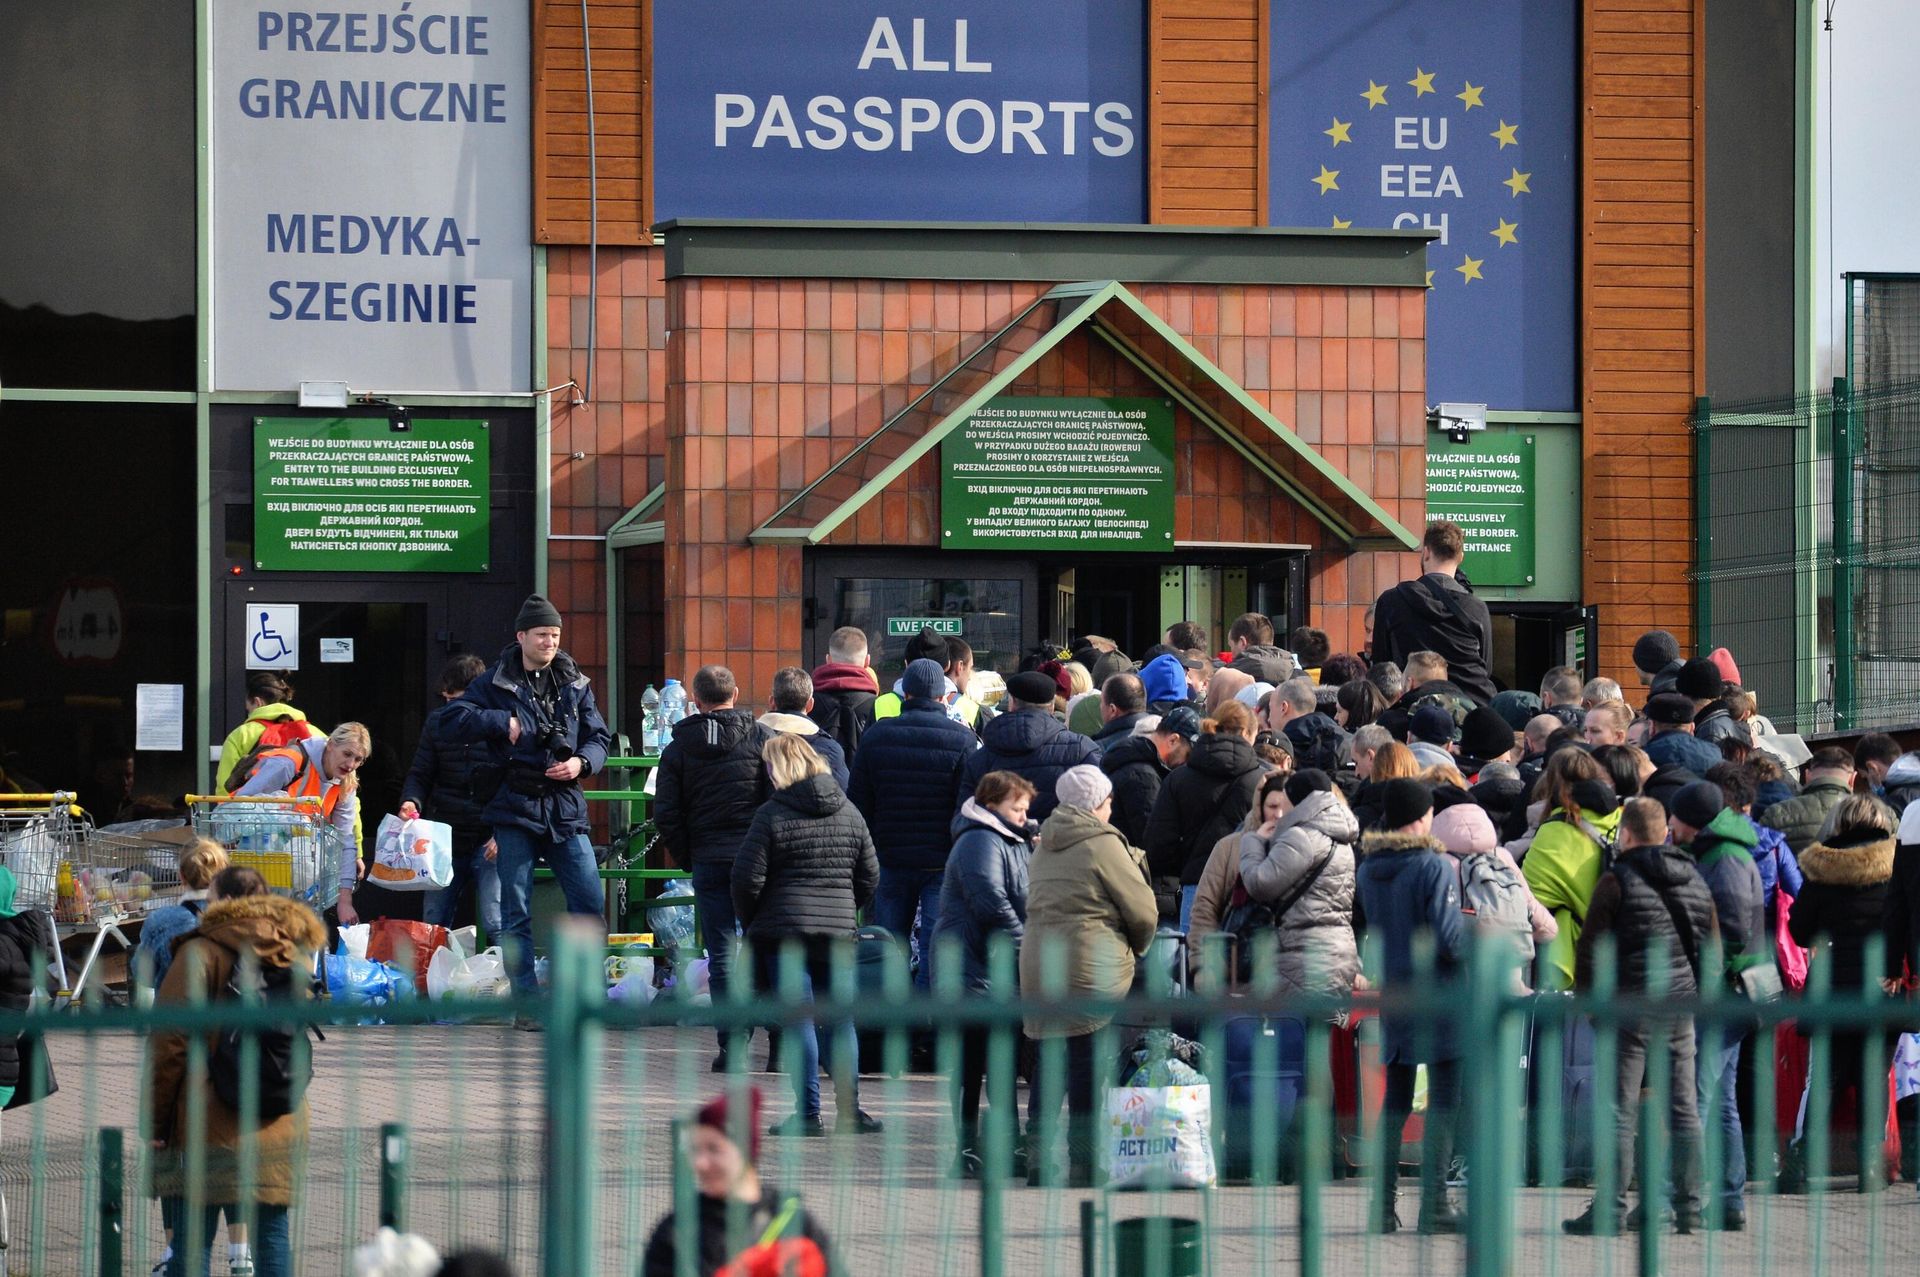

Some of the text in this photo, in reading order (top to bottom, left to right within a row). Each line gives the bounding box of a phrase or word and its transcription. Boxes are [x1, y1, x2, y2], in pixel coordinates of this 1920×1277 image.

[257, 2, 489, 56] PRZEJŚCIE
[856, 16, 992, 73] ALL
[239, 78, 507, 123] GRANICZNE
[714, 93, 1134, 157] PASSPORTS
[1394, 117, 1447, 150] EU
[1381, 164, 1463, 198] EEA
[266, 213, 481, 257] MEDYKA-
[268, 280, 477, 324] SZEGINIE
[1006, 409, 1018, 418] DO
[1019, 409, 1058, 418] BUDYNKU
[1059, 410, 1106, 420] WYŁĄCZNIE
[1108, 410, 1124, 419] DLA
[1125, 408, 1146, 420] OSÓB
[970, 419, 1146, 432] PRZEKRACZAJĄCYCH GRANICĘ PAŃSTWOWĄ.
[966, 429, 1150, 441] DO WEJŚCIA PROSIMY WCHODZIĆ POJEDYNCZO.
[268, 437, 474, 450] WEJŚCIE DO BUDYNKU WYŁĄCZNIE DLA OSÓB
[975, 442, 983, 450] W
[984, 442, 1032, 451] PRZYPADKU
[1034, 440, 1065, 451] DUŻEGO
[1067, 440, 1099, 452] BAGAŻU
[270, 451, 473, 464] PRZEKRACZAJĄCYCH GRANICĘ PAŃSTWOWĄ.
[987, 452, 1129, 463] PROSIMY O KORZYSTANIE Z WEJŚCIA
[1477, 455, 1495, 463] DLA
[1496, 453, 1520, 464] OSÓB
[284, 465, 459, 475] ENTRY TO THE BUILDING EXCLUSIVELY
[954, 463, 1027, 472] PRZEZNACZONEGO
[1028, 464, 1045, 473] DLA
[1046, 462, 1068, 473] OSÓB
[1426, 467, 1519, 479] RANICĘ PAŃSTWOWĄ.
[271, 477, 472, 488] FOR TRAWELLERS WHO CROSS THE BORDER.
[1426, 482, 1524, 493] CHODZIĆ POJEDYNCZO.
[968, 485, 988, 495] ВХІД
[1033, 486, 1051, 496] ДЛЯ
[1052, 486, 1071, 495] ОСІБ
[1073, 486, 1086, 495] ЯКІ
[1088, 486, 1148, 496] ПЕРЕТИНАЮТЬ
[1013, 494, 1066, 507] ДЕРЖАВНИЙ
[267, 502, 290, 512] ВХІД
[343, 503, 364, 513] ДЛЯ
[365, 503, 387, 512] ОСІБ
[389, 504, 405, 513] ЯКІ
[407, 504, 476, 513] ПЕРЕТИНАЮТЬ
[988, 507, 1000, 517] ДО
[1002, 507, 1029, 517] ВХОДУ
[1031, 508, 1077, 518] ПІДХОДИТИ
[1079, 508, 1090, 517] ПО
[320, 514, 381, 527] ДЕРЖАВНИЙ
[967, 518, 972, 526] У
[974, 518, 1013, 528] ВИПАДКУ
[1014, 518, 1057, 528] ВЕЛИКОГО
[1058, 519, 1091, 528] БАГАЖУ
[1446, 514, 1506, 522] EXCLUSIVELY
[285, 528, 314, 539] ДВЕРІ
[315, 529, 352, 539] БУДУТЬ
[410, 530, 422, 539] ЯК
[424, 530, 458, 539] ТІЛЬКИ
[1058, 530, 1078, 540] ВХІД
[1080, 530, 1098, 540] ДЛЯ
[1480, 529, 1518, 537] BORDER.
[291, 541, 358, 551] НАТИСНЕТЬСЯ
[360, 542, 397, 551] КНОПКУ
[1463, 544, 1511, 552] ENTRANCE
[1118, 1136, 1177, 1156] ACTION
